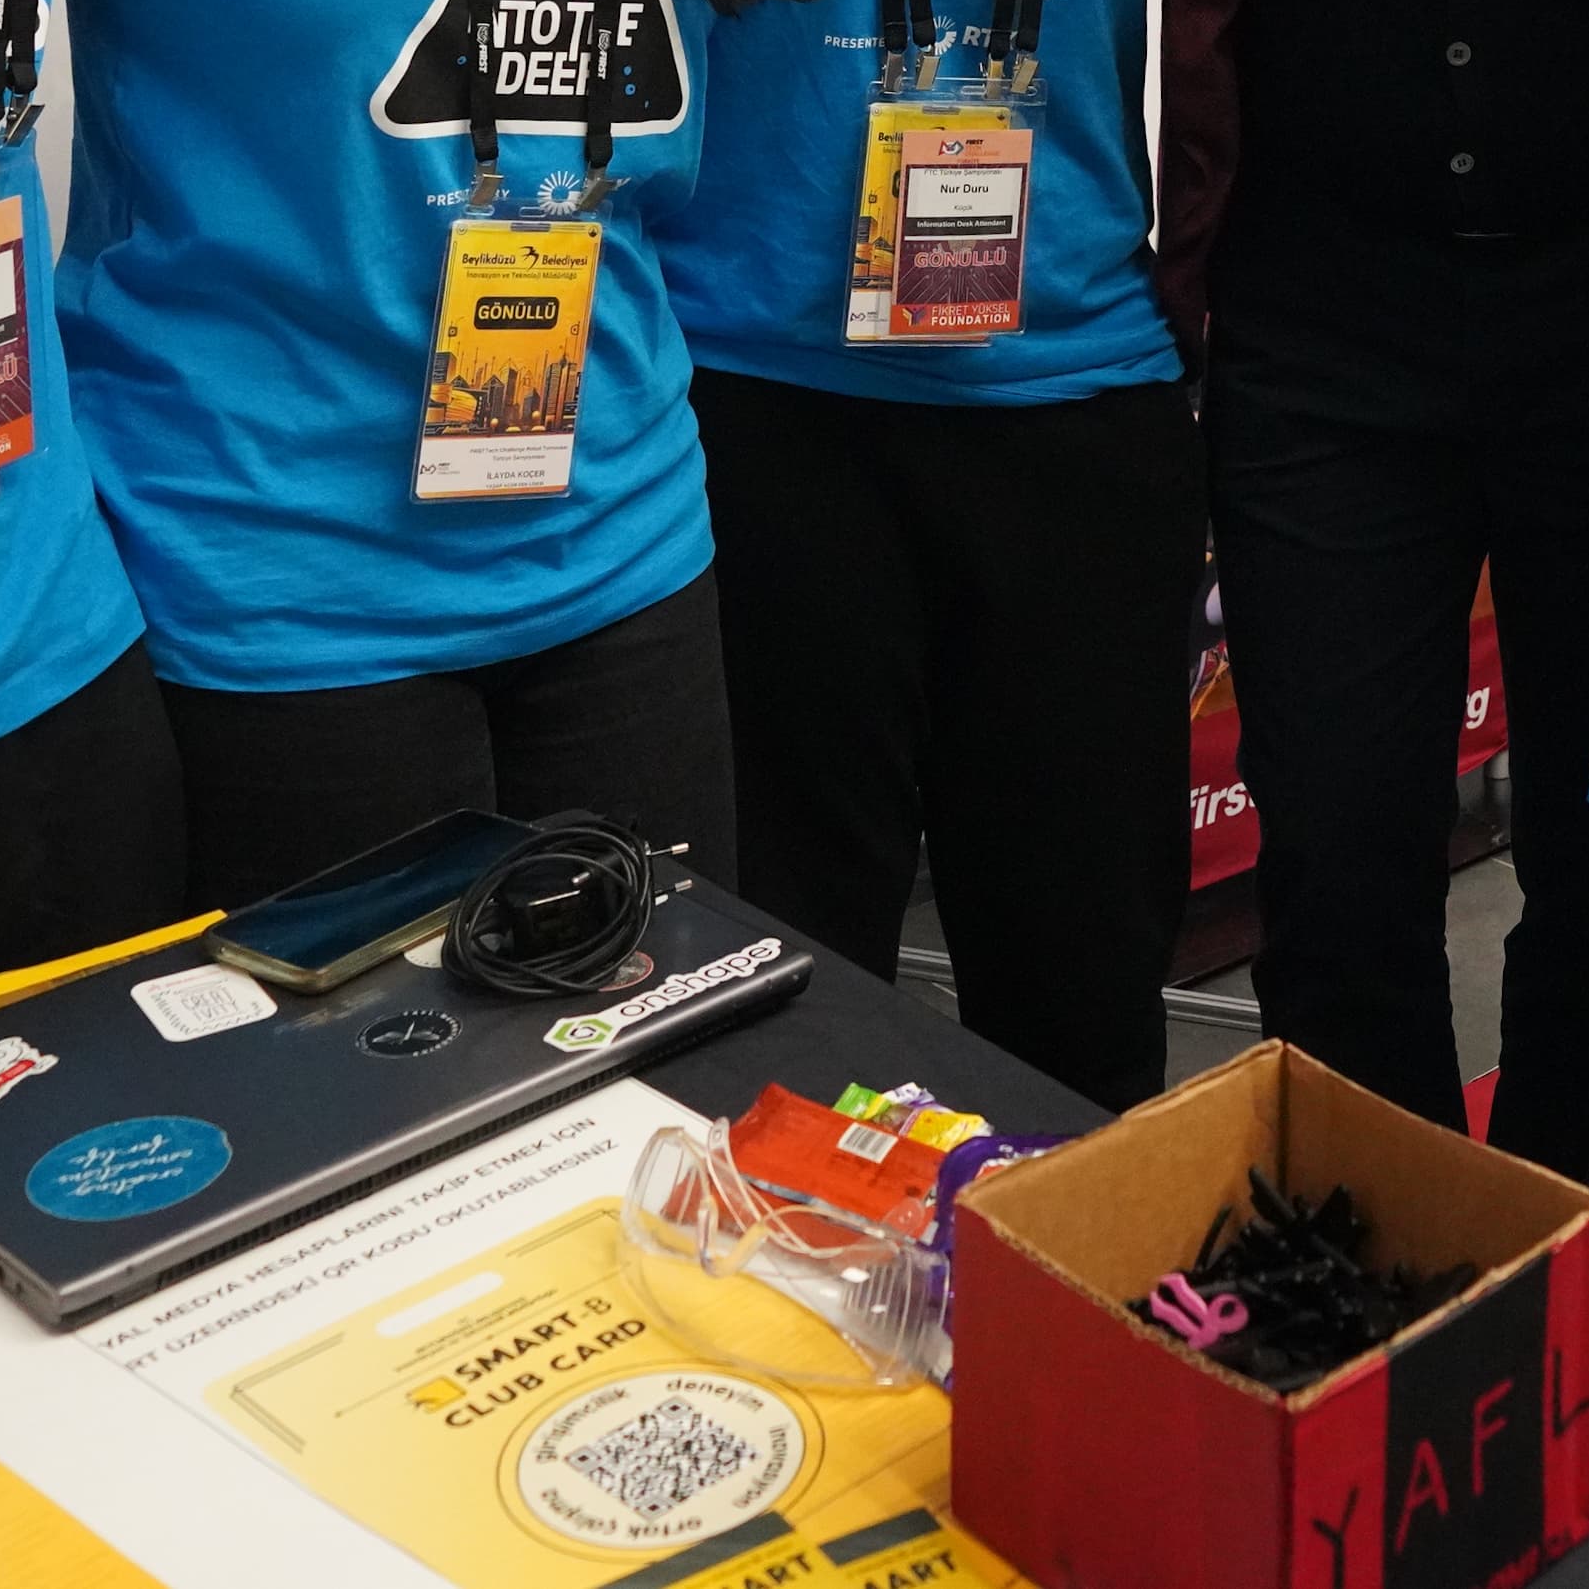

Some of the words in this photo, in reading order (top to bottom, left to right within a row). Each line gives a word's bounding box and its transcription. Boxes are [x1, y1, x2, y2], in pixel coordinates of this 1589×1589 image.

[824, 34, 885, 50] PRESENTE
[478, 44, 489, 74] FIRST
[597, 50, 607, 80] FIRST
[940, 184, 960, 194] Nur
[963, 183, 989, 194] Duru
[917, 220, 955, 228] Information
[975, 219, 1006, 227] Attendant
[462, 252, 516, 266] Beylikdüzü
[542, 254, 588, 266] Belediyesi
[914, 247, 1007, 268] GÖNÜLLÜ
[478, 301, 557, 321] GÖNÜLLÜ
[931, 305, 968, 317] FİKRET
[971, 302, 1010, 315] YÜKSEL
[931, 313, 1011, 327] FOUNDATION
[518, 470, 545, 479] KOÇER
[620, 945, 773, 1017] onshape
[152, 1282, 245, 1327] MEDYA
[244, 1204, 405, 1288] HESAPLARINI
[404, 1171, 471, 1210] TAKİP
[473, 1138, 549, 1182] ETMEK
[550, 1116, 597, 1146] İÇİN
[165, 1274, 321, 1356] ÜZERİNDEKİ
[322, 1256, 361, 1283] QR
[362, 1225, 432, 1263] KODU
[434, 1138, 621, 1229] OKUTABİLİRSİNİZ
[454, 1296, 613, 1383] SMART-B
[445, 1372, 544, 1429] CLUB
[550, 1319, 647, 1372] CARD
[666, 1376, 764, 1413] deneyim
